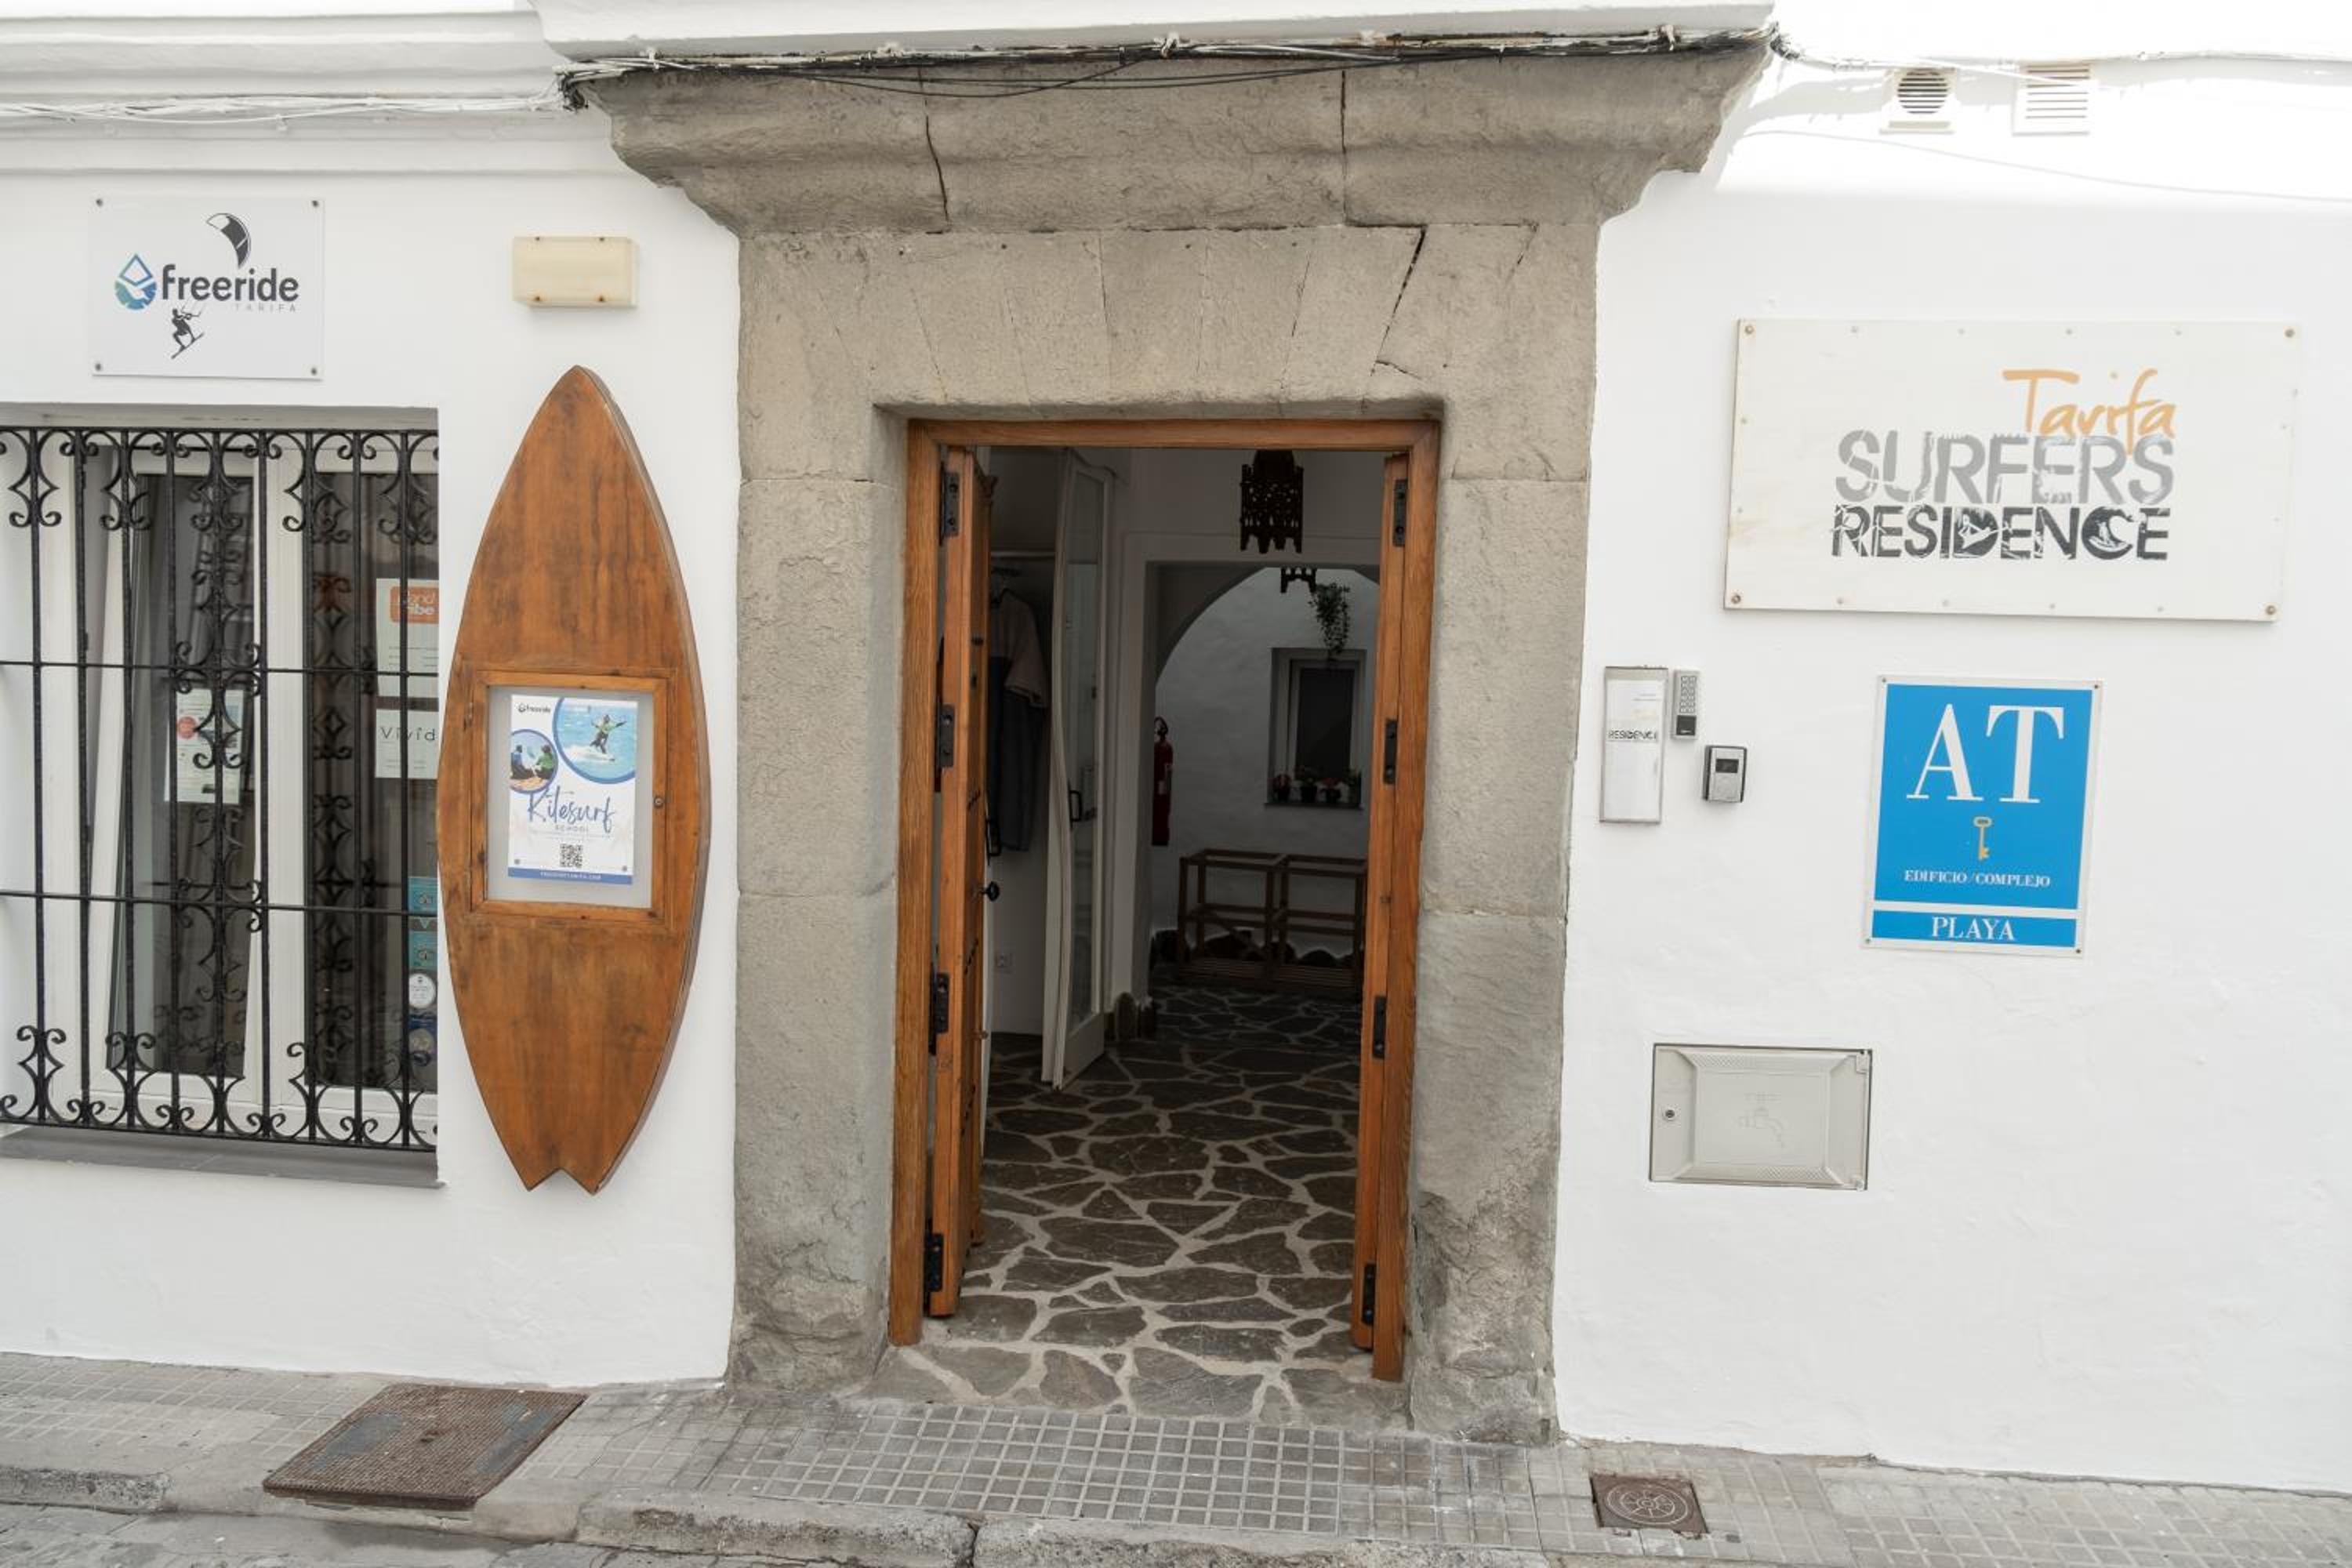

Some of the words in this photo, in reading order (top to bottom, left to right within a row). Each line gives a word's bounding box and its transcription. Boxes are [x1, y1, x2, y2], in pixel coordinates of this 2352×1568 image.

[162, 263, 299, 302] freeride
[234, 303, 296, 313] TARIFA
[2002, 368, 2177, 457] Tarifa
[1835, 428, 2176, 506] SURFERS
[1830, 503, 2171, 561] RESIDENCE
[1906, 702, 2064, 804] AT
[528, 785, 615, 833] Kitesurf
[1904, 869, 1968, 884] EDIFICIO
[1975, 871, 2051, 887] COMPLEJO
[1931, 915, 2016, 941] PLAYA
